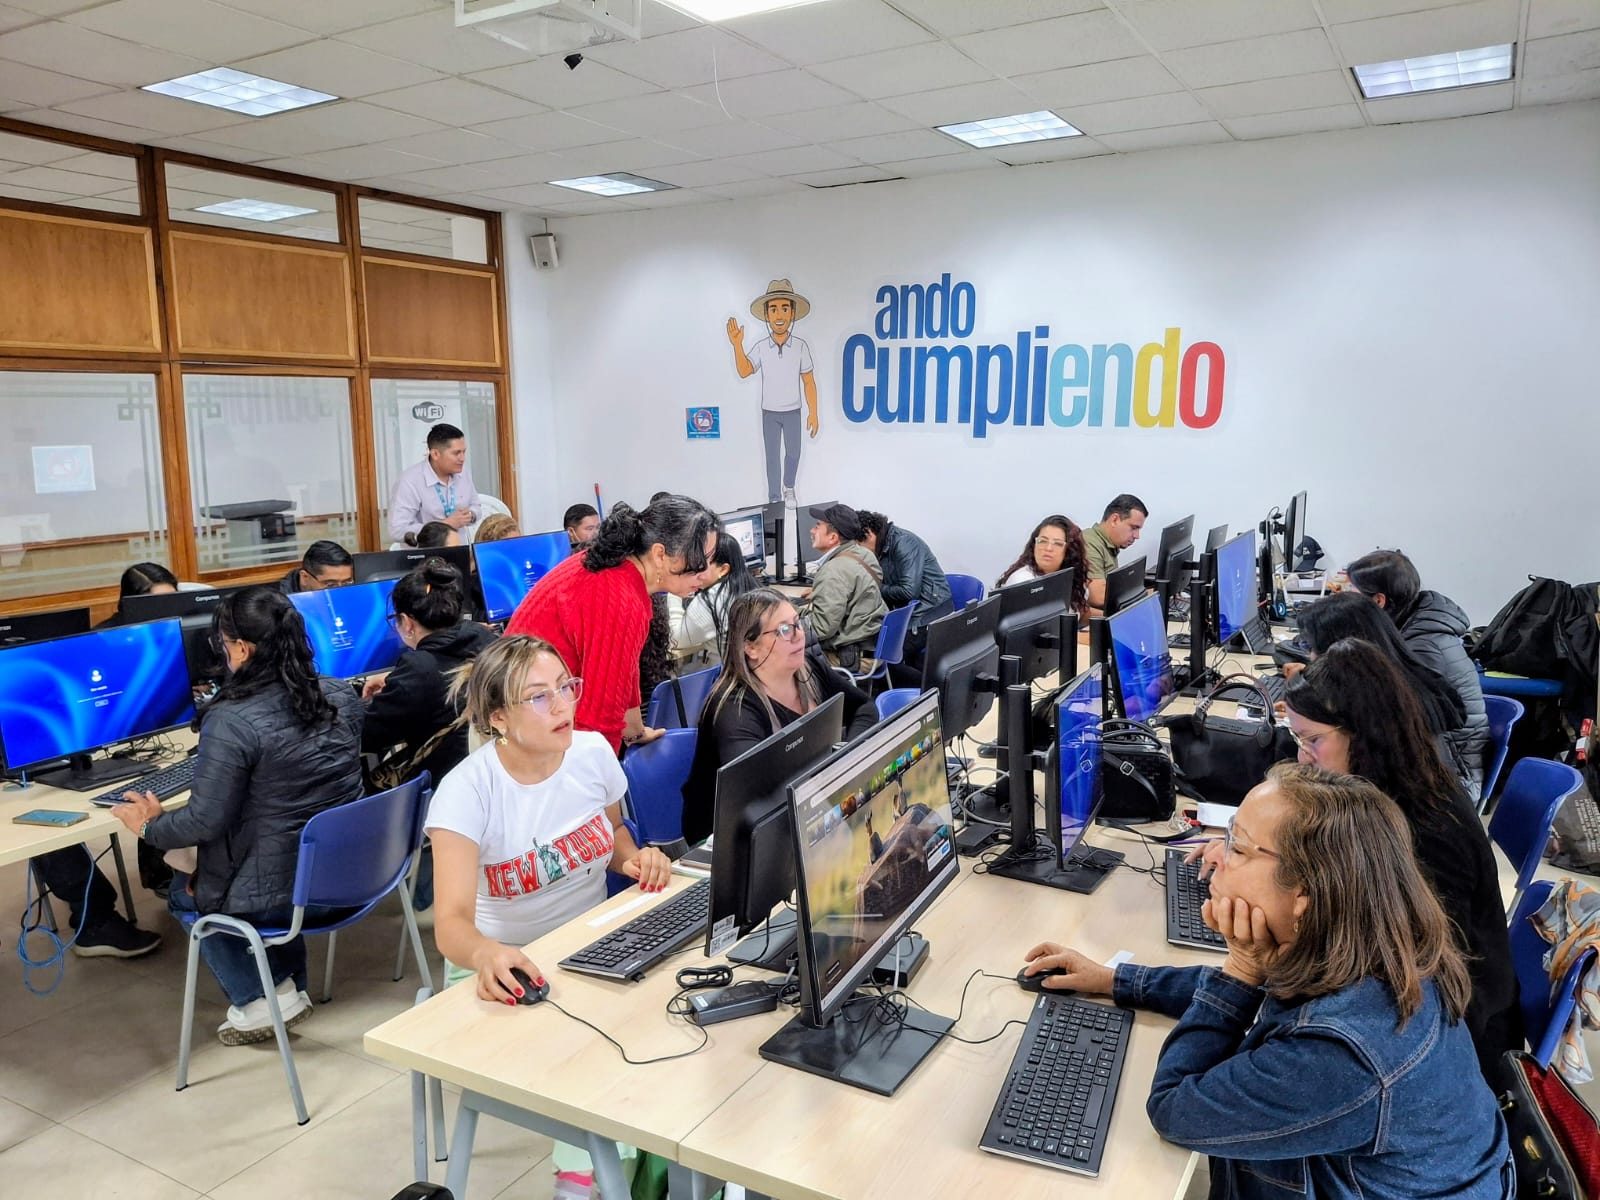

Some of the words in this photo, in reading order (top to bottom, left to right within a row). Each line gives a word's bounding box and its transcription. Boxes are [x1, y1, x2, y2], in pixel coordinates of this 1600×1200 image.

[875, 273, 976, 340] ando
[842, 325, 1226, 438] Cumpliendo
[484, 849, 542, 898] NEW
